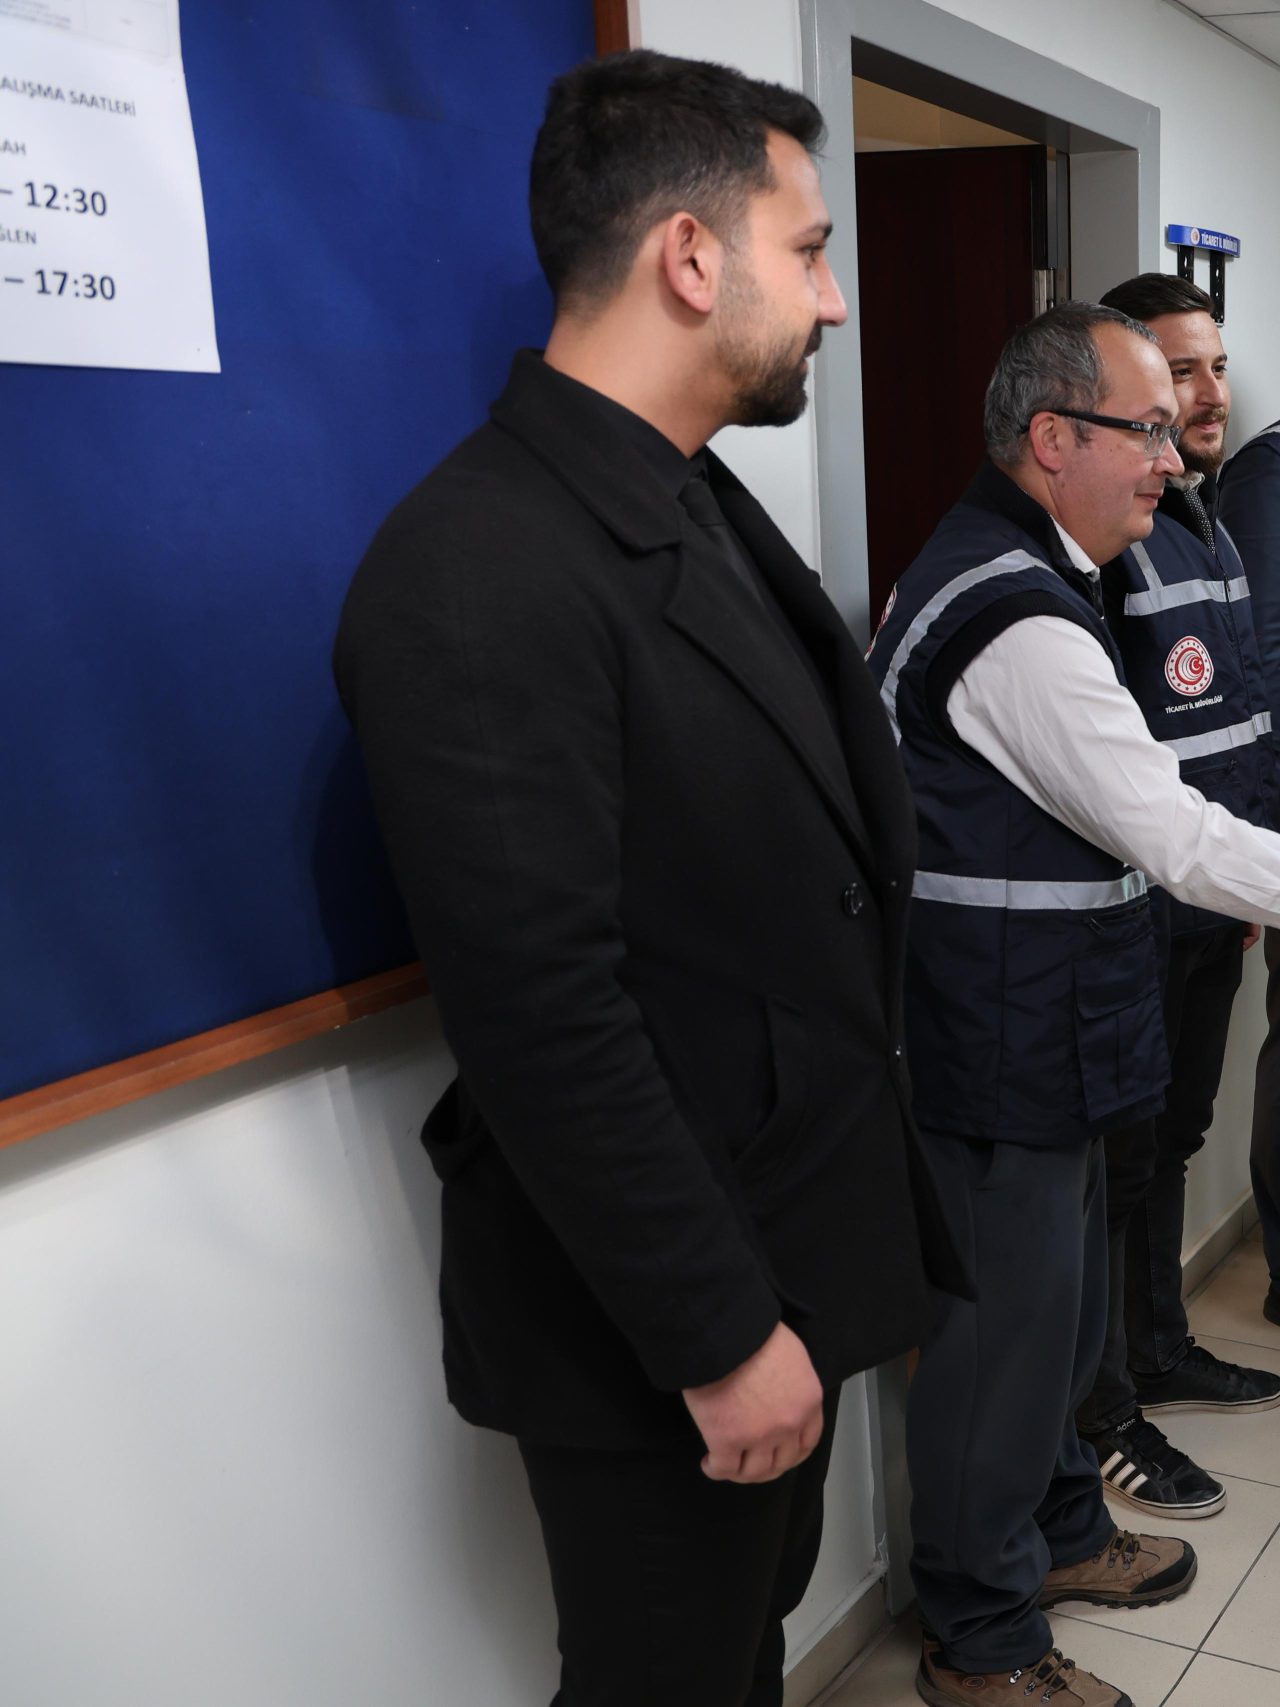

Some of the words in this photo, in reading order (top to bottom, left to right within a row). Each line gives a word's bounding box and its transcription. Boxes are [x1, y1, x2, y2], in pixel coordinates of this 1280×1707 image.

[69, 90, 136, 117] SAATLERİ
[0, 139, 27, 156] AH
[25, 181, 107, 217] 12:30
[35, 269, 116, 301] 17:30
[1165, 703, 1189, 714] TİCARET
